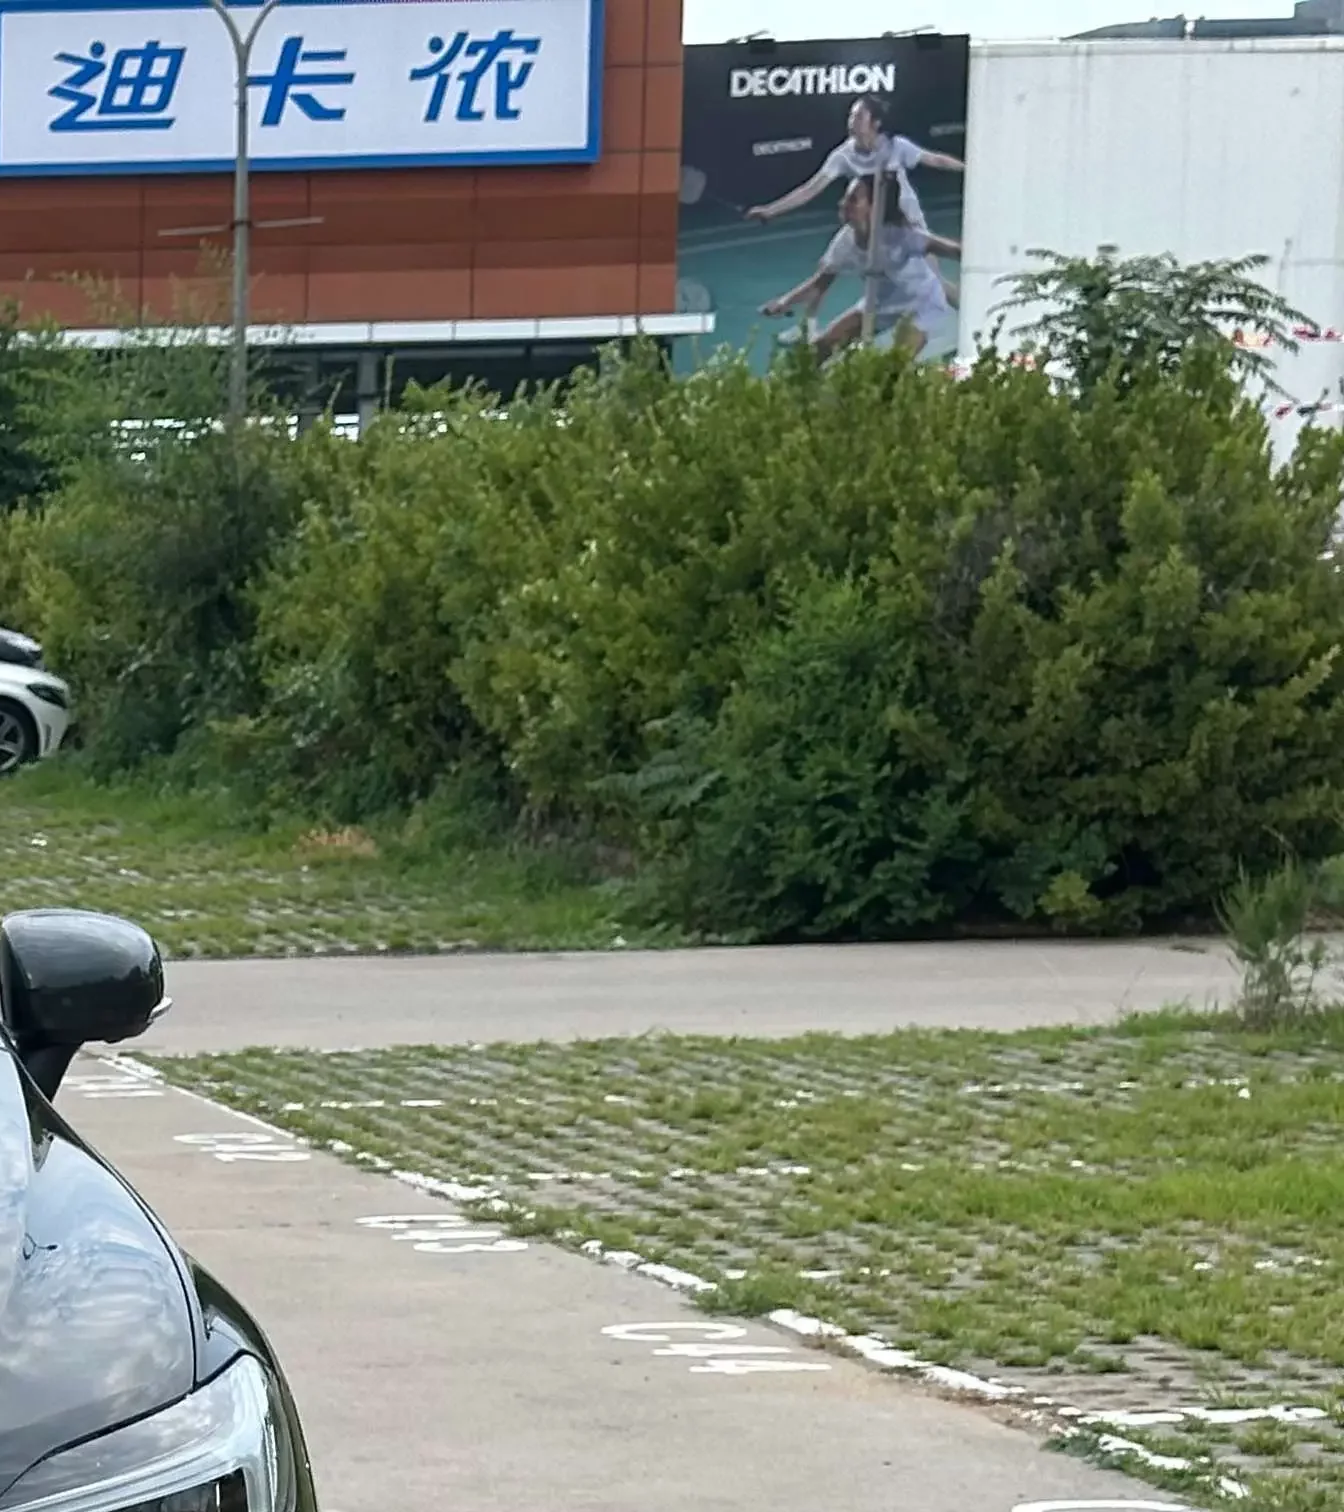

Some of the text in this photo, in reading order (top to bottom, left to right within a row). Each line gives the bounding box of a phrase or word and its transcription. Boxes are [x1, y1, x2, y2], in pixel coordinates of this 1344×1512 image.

[48, 29, 541, 133] 迪卡侬
[730, 63, 896, 98] DECATHLON
